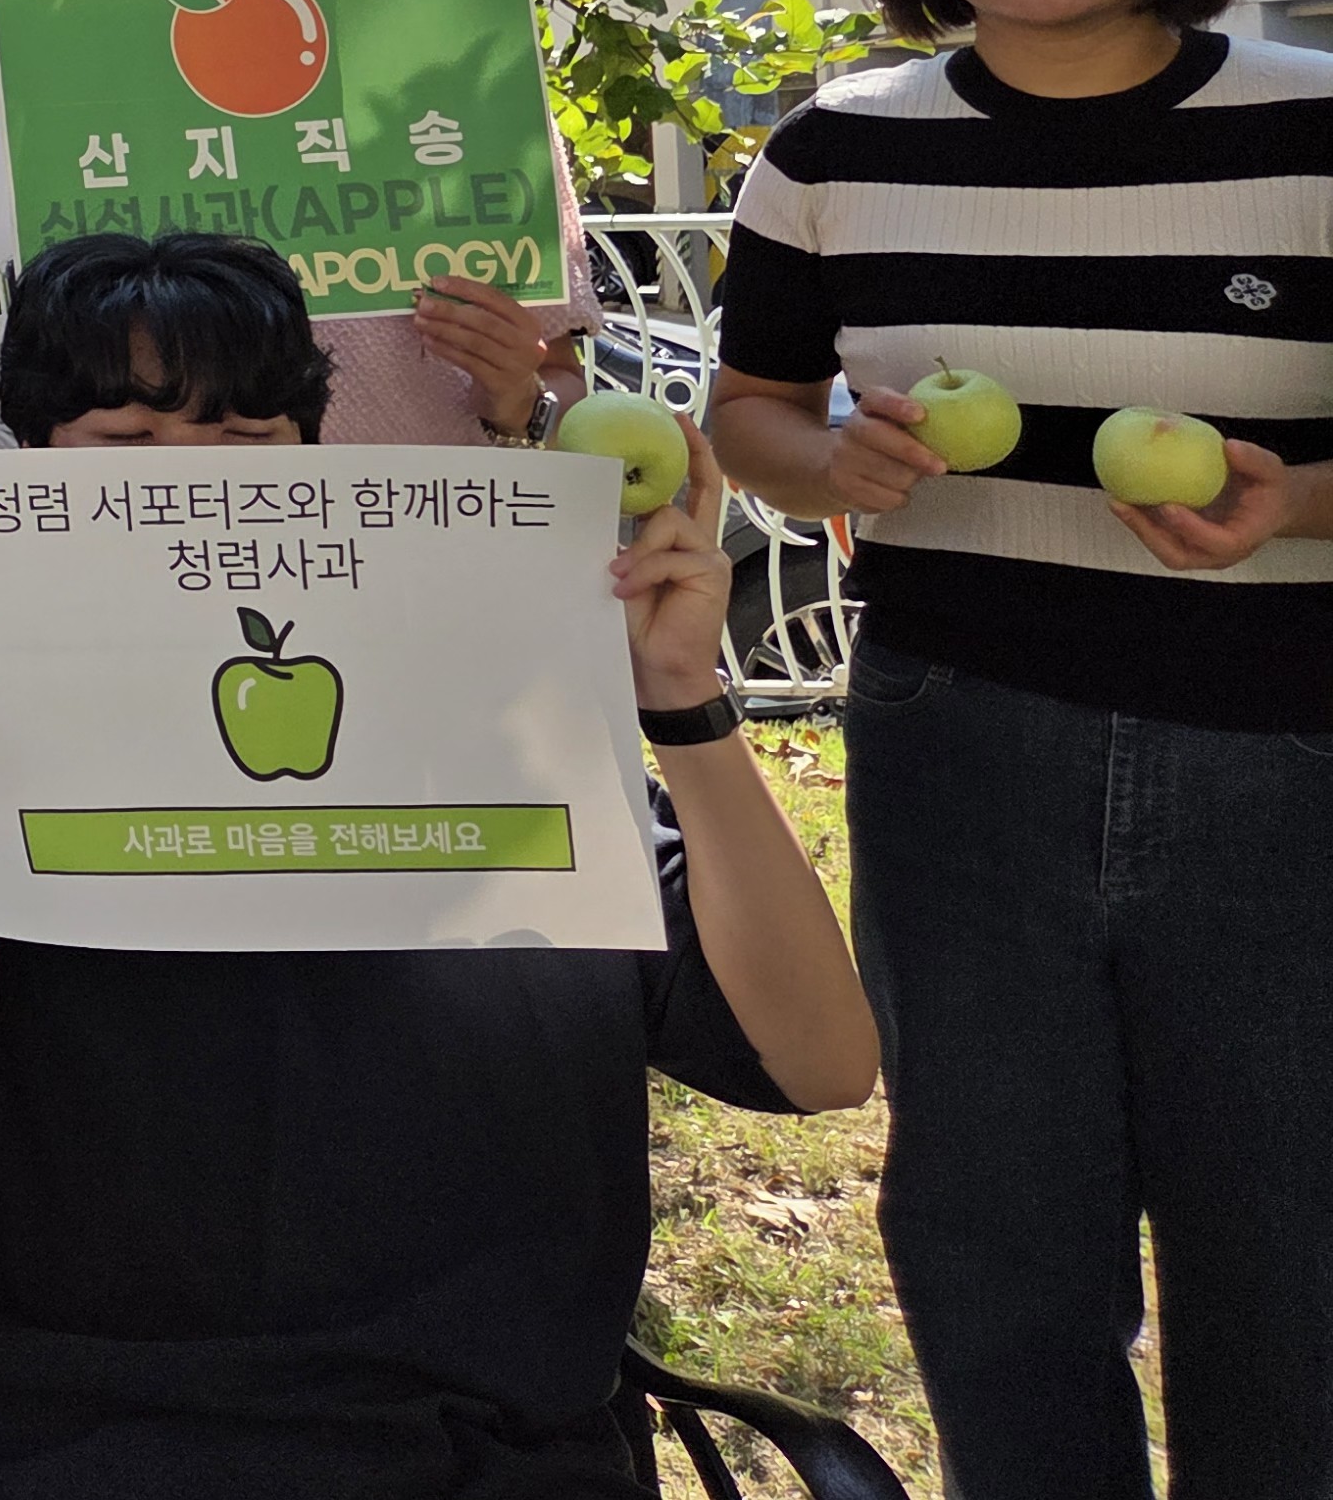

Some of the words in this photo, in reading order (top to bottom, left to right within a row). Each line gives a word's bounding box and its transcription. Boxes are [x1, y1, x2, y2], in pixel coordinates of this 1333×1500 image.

[79, 133, 129, 188] 산
[186, 126, 238, 180] 지
[295, 118, 351, 172] 직
[409, 110, 463, 166] 송
[90, 477, 336, 532] 서포터즈와
[351, 476, 557, 530] 함께하는
[167, 536, 365, 592] 청렴사과
[124, 824, 217, 859] 사과로
[226, 823, 318, 857] 마음을
[328, 821, 487, 856] 전해보세요
